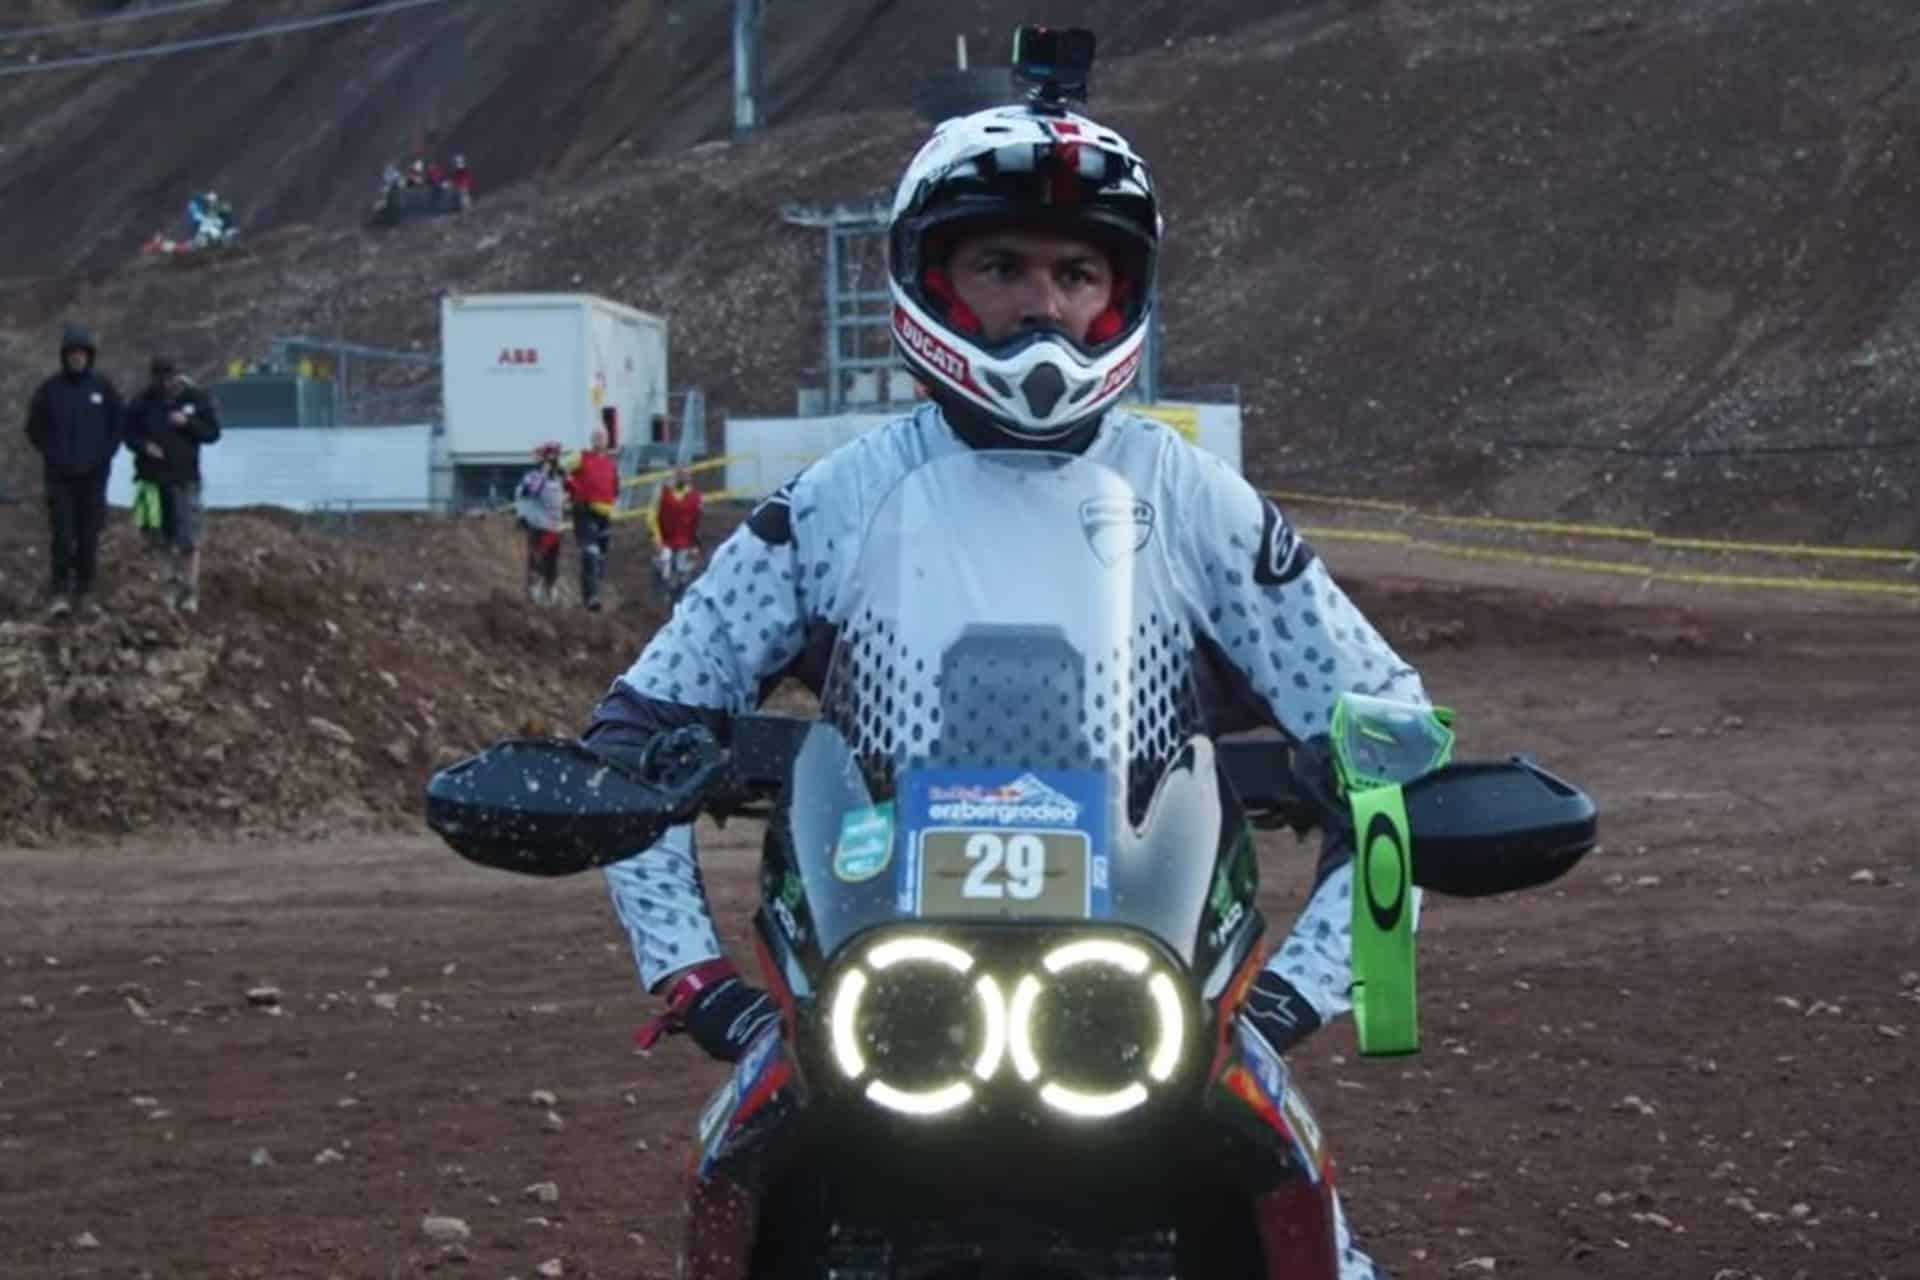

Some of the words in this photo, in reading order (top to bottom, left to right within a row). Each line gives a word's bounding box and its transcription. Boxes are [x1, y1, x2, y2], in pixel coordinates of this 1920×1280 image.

[498, 347, 538, 365] ABB
[902, 318, 965, 381] DUCATI
[929, 800, 1078, 824] erzbergrodeo
[963, 832, 1045, 900] 29
